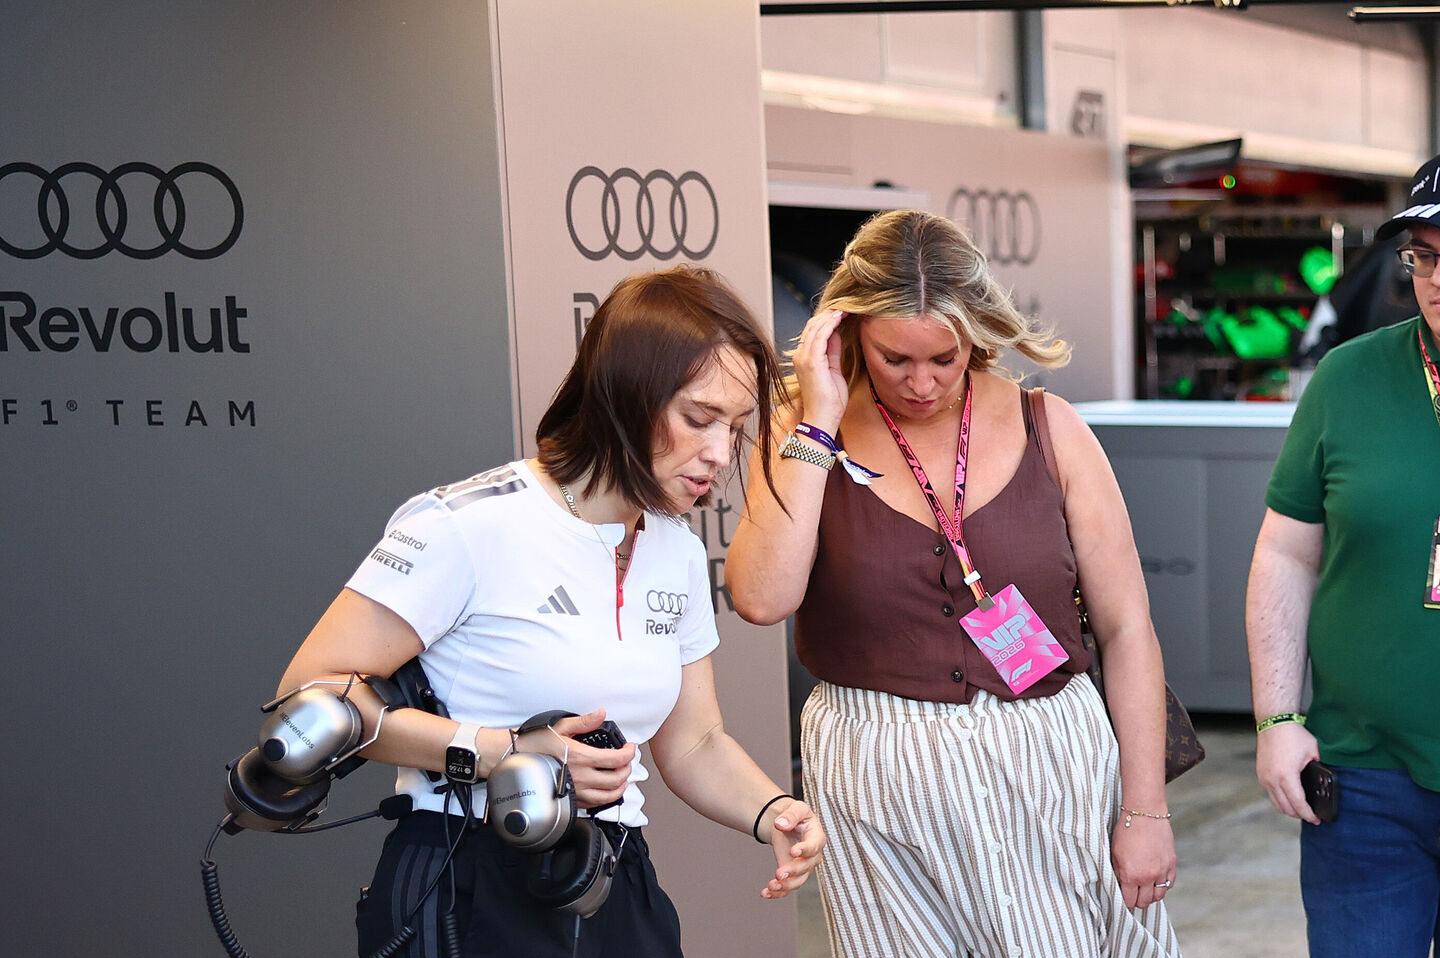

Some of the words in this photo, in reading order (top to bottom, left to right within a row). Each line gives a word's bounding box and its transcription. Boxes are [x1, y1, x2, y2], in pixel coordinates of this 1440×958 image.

[0, 290, 250, 353] Revolut
[106, 400, 256, 427] TEAM
[392, 529, 428, 552] Castrol
[371, 548, 414, 576] PIRELLI
[980, 614, 1027, 651] VIP
